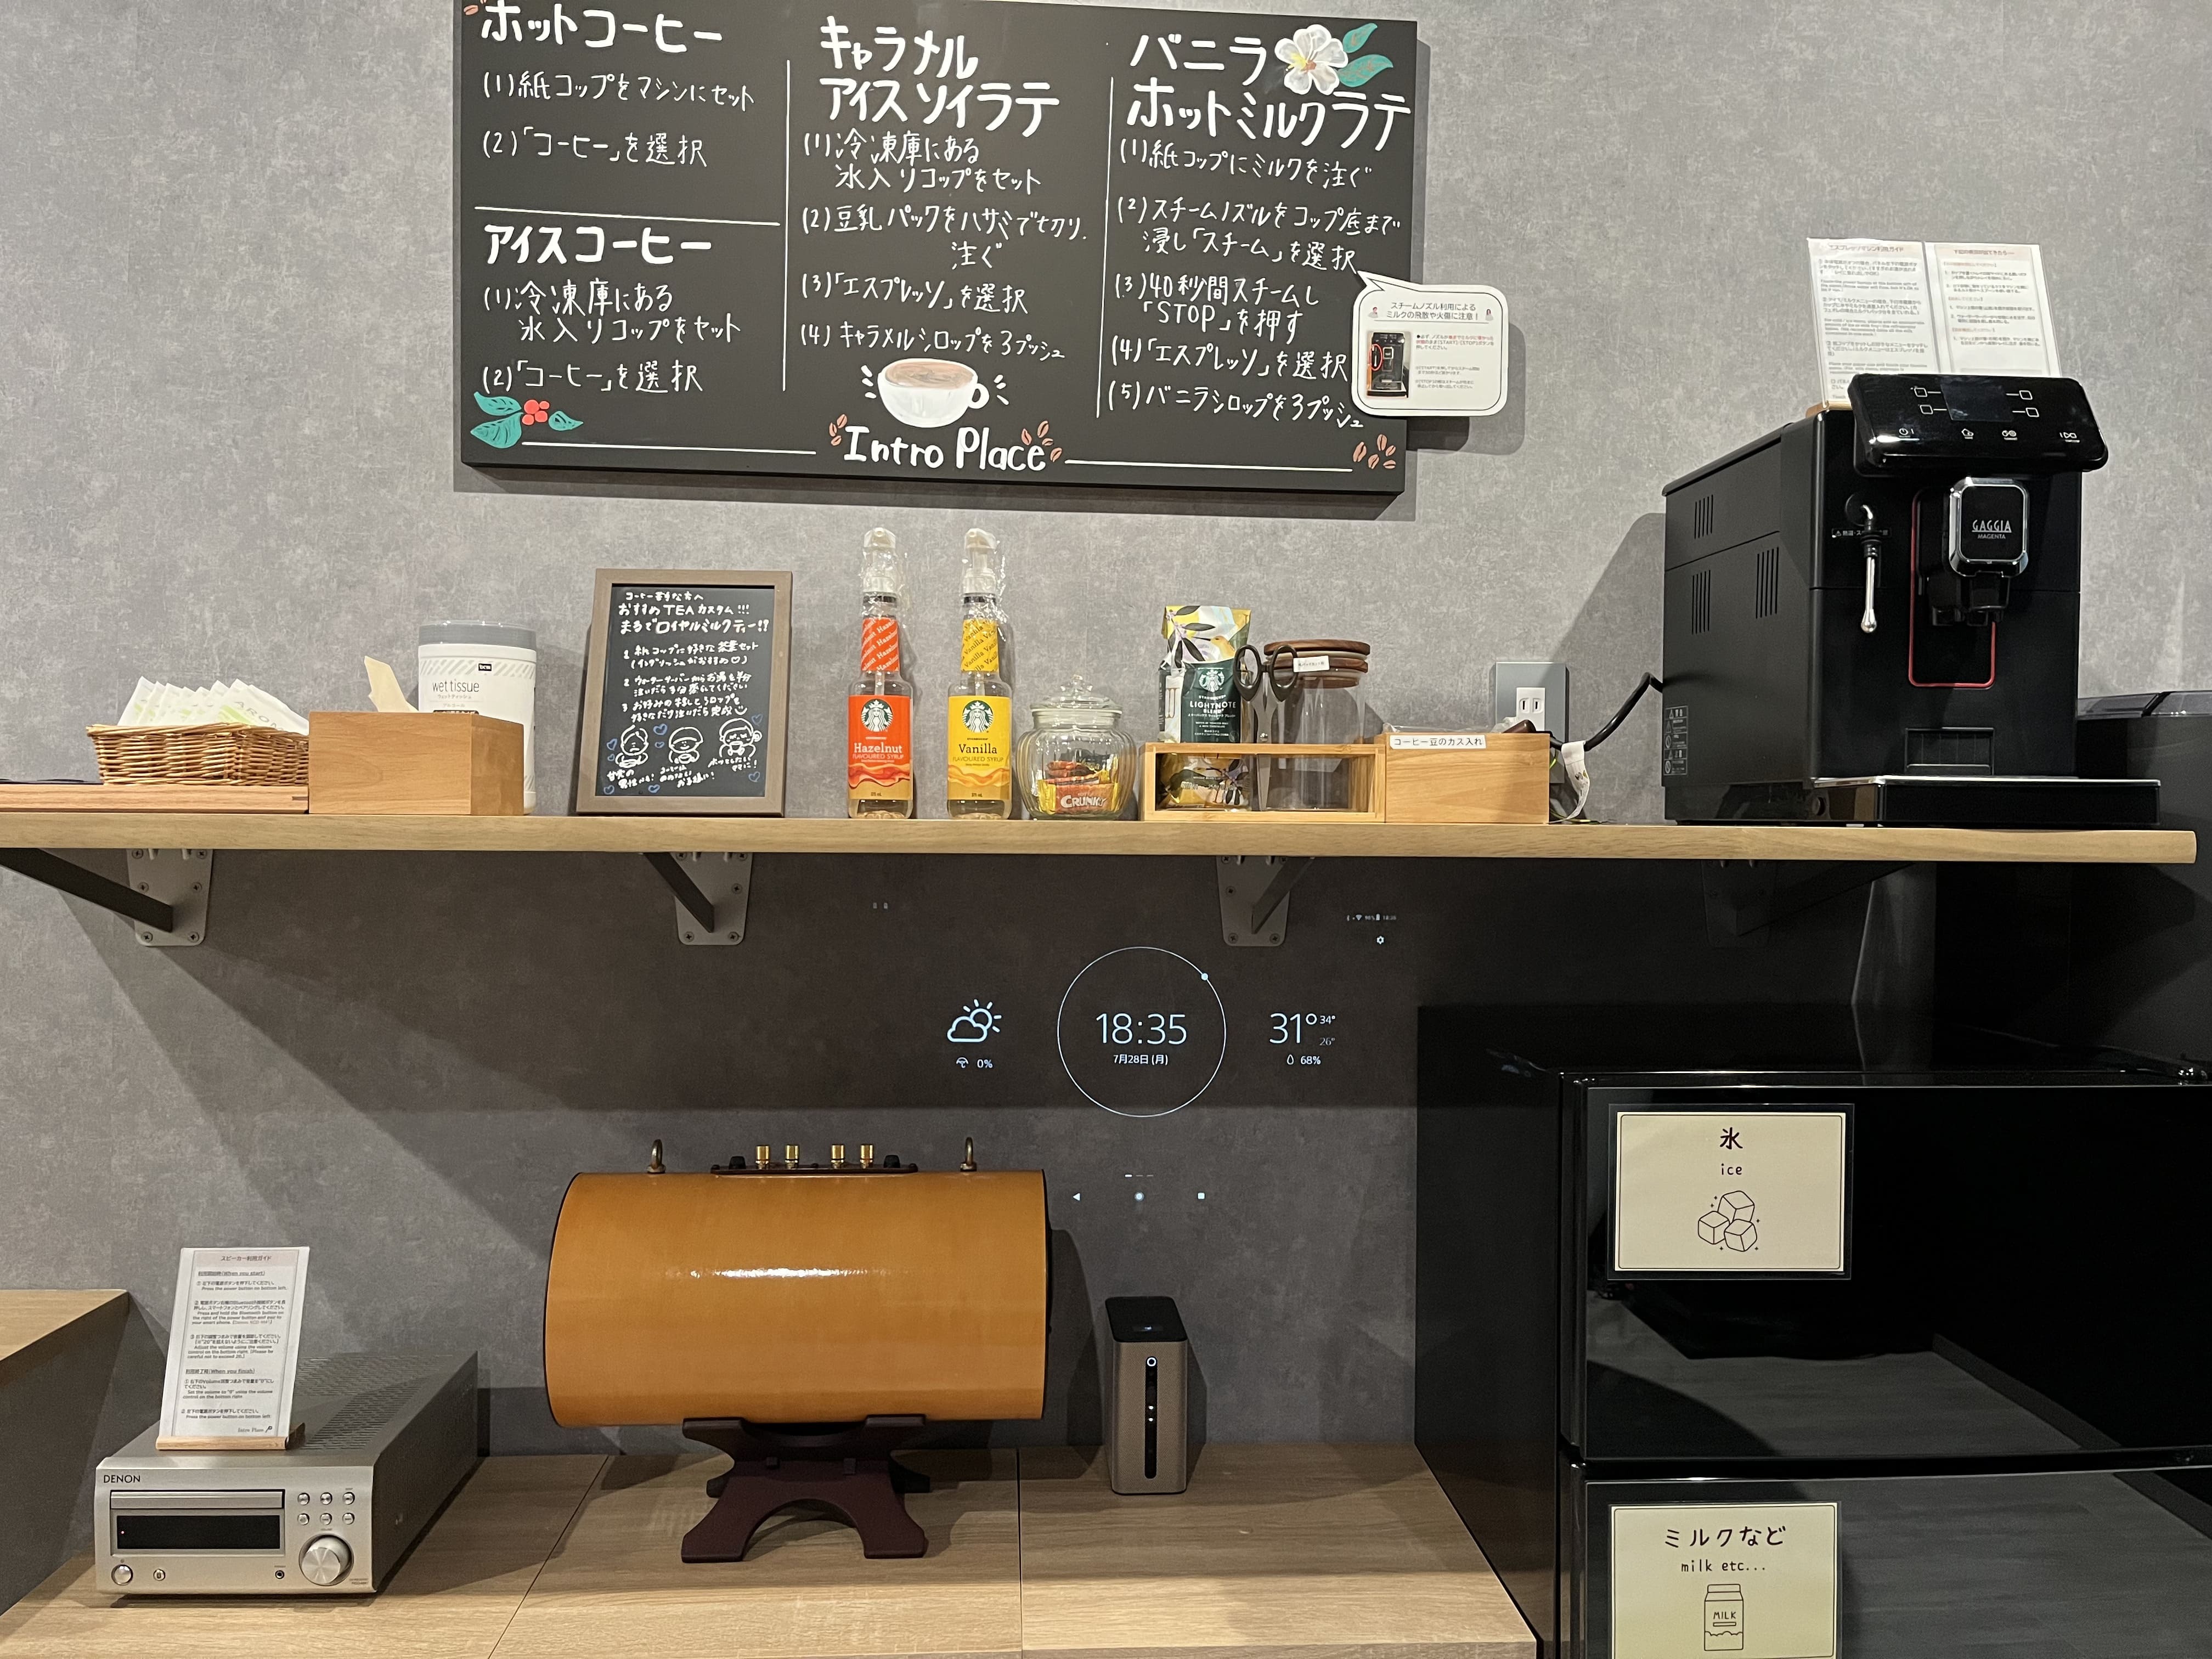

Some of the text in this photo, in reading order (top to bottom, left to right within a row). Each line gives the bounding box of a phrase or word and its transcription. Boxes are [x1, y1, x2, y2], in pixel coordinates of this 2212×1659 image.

[481, 0, 723, 53] ホットコーヒー
[821, 15, 978, 79] キャラメル
[1130, 34, 1267, 86] バニラ
[1126, 77, 1410, 151] ホットミルクラテ
[484, 224, 712, 264] アイスコーヒー
[951, 241, 1002, 269] 注ぐ
[844, 426, 1046, 471] Intro Place
[1972, 520, 2012, 533] GAGGIA
[964, 639, 984, 654] Vanilla
[964, 652, 985, 667] Vanilla
[433, 679, 479, 692] wet tissue
[1190, 701, 1236, 709] LIGHTNOTE
[854, 742, 902, 753] Hazelnut
[959, 743, 997, 754] Vanilla
[1393, 737, 1483, 747] コーヒー豆のカス入れ
[1060, 795, 1106, 808] CRUNKY
[1319, 1014, 1336, 1025] 34°
[1096, 1013, 1187, 1045] 18:35
[1269, 1013, 1317, 1044] 31°
[977, 1059, 993, 1069] 0%
[1113, 1054, 1168, 1065] 7月28日 (月)
[1300, 1056, 1321, 1065] 68%
[1720, 1127, 1743, 1149] 氷
[1721, 1163, 1742, 1176] ice
[103, 1475, 140, 1483] DENON
[1665, 1526, 1786, 1548] ミルクなど
[1681, 1559, 1765, 1572] milk etc...
[1713, 1611, 1736, 1620] MILK
